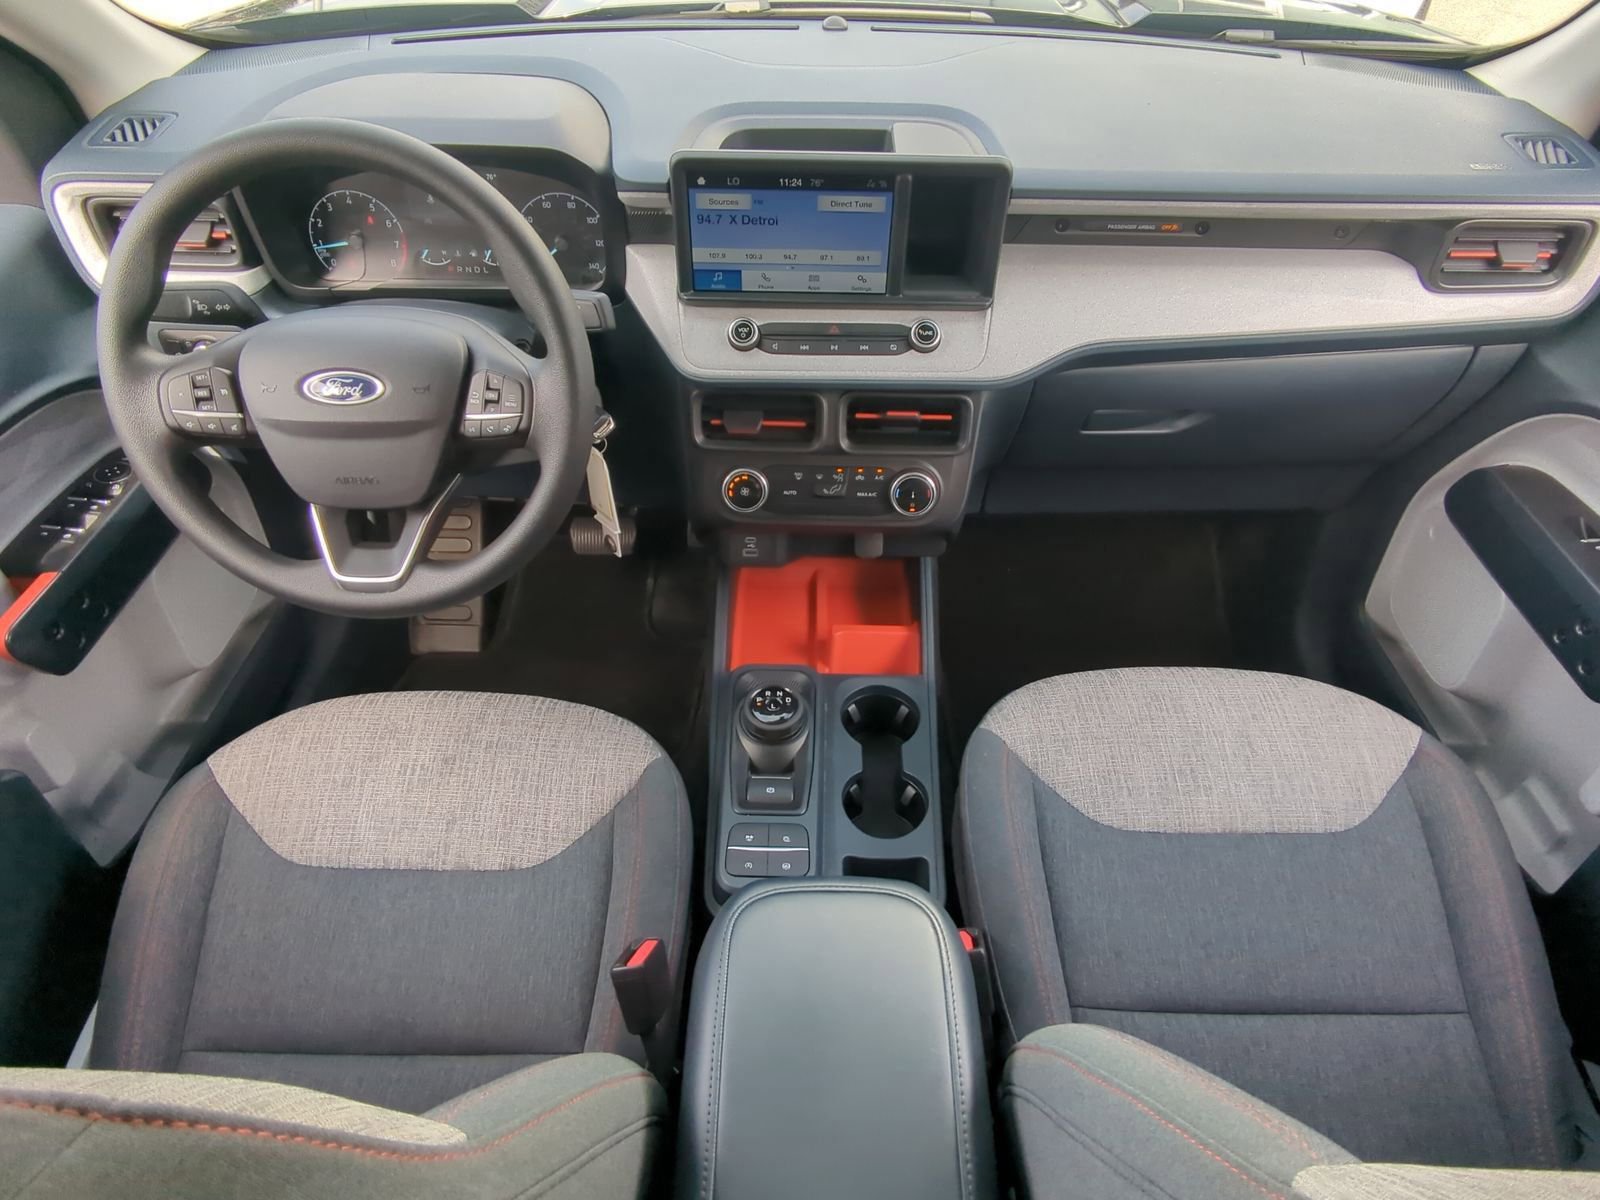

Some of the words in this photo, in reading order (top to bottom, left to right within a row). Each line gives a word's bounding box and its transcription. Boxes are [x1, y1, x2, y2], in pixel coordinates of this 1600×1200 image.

[727, 177, 740, 185] LO
[779, 178, 802, 187] 11:24
[346, 196, 352, 204] 4
[708, 198, 739, 206] Sources
[327, 203, 333, 212] 3
[369, 203, 375, 212] 5
[542, 201, 551, 209] 60
[567, 201, 576, 209] 80
[830, 200, 852, 208] Direct
[854, 201, 873, 209] Tune
[316, 218, 323, 227] 2
[385, 220, 392, 228] 6
[586, 216, 598, 224] 100
[697, 214, 722, 225] 94.7
[729, 214, 738, 225] X
[741, 215, 779, 226] Detroi
[393, 240, 399, 249] 7
[330, 258, 337, 266] 0
[321, 377, 364, 398] Ford
